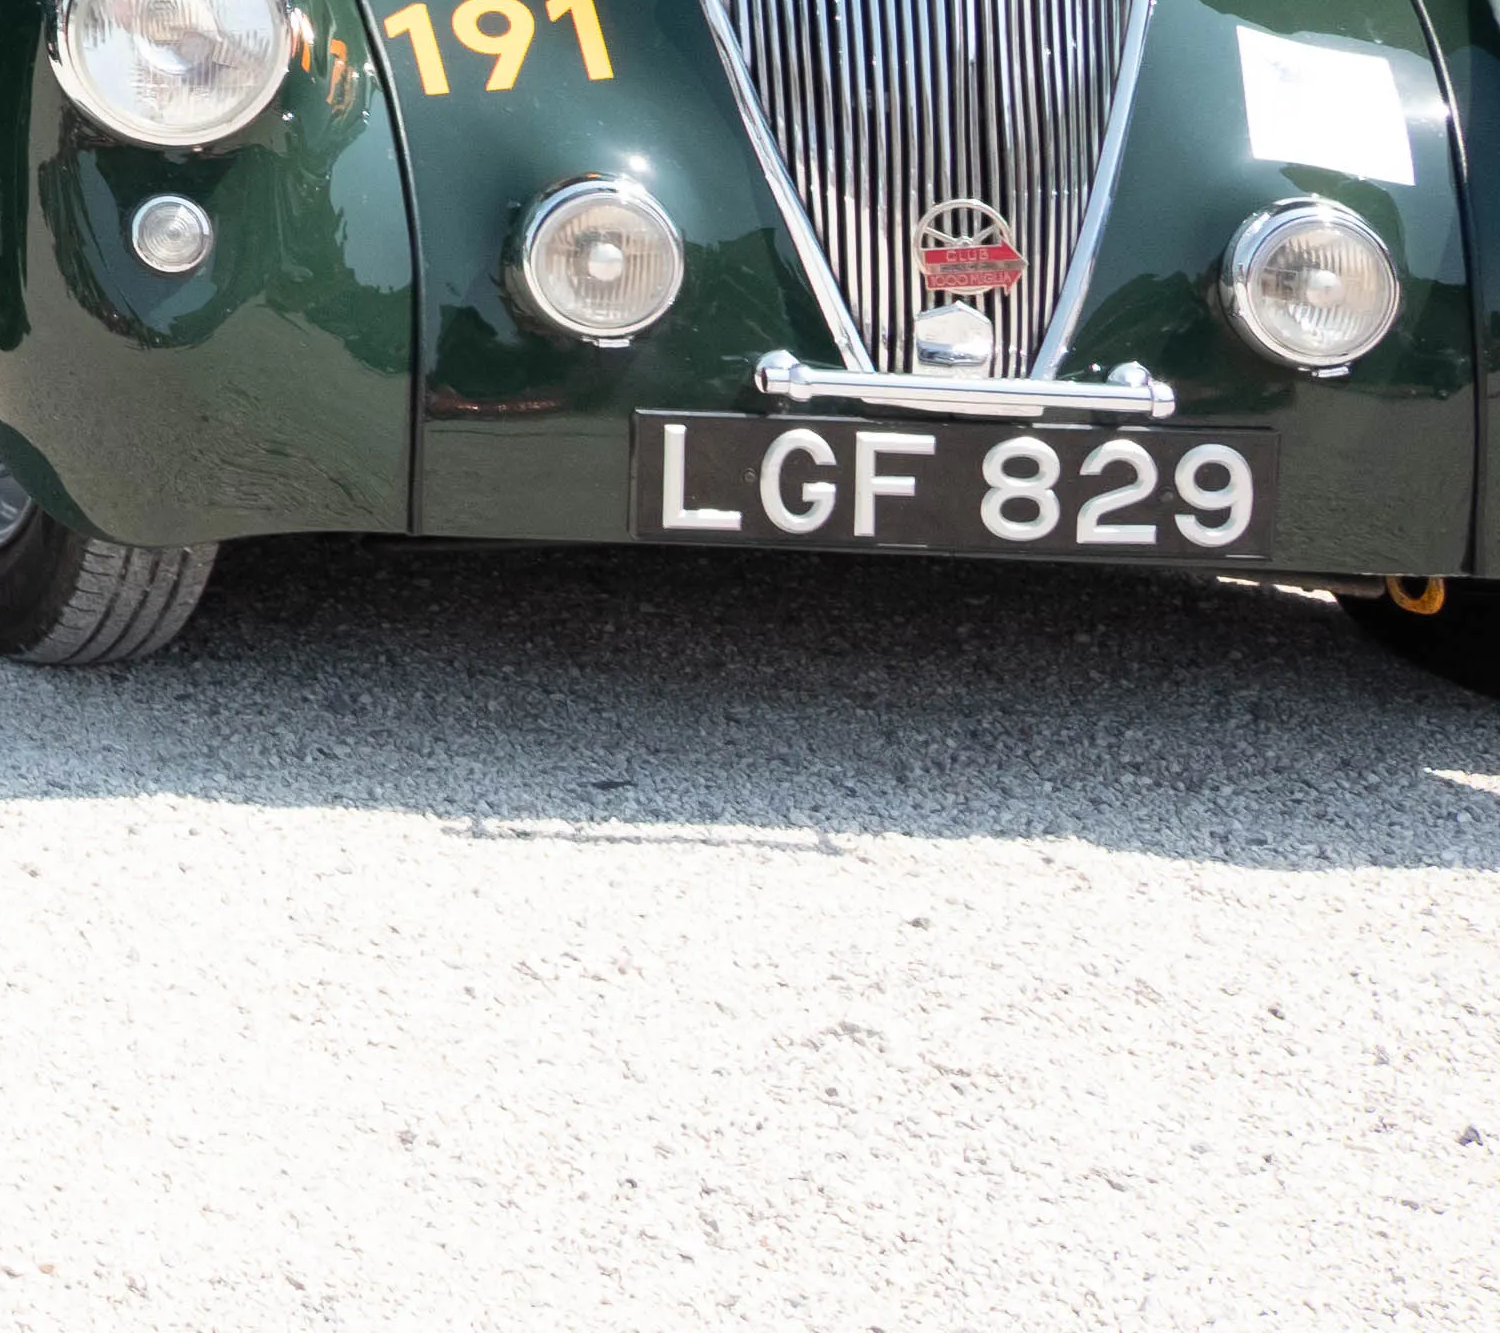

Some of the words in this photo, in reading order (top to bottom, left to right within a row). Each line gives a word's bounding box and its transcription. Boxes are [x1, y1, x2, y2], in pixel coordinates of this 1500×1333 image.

[946, 248, 989, 263] CLUB
[661, 423, 936, 538] LGF
[980, 435, 1255, 549] 829
